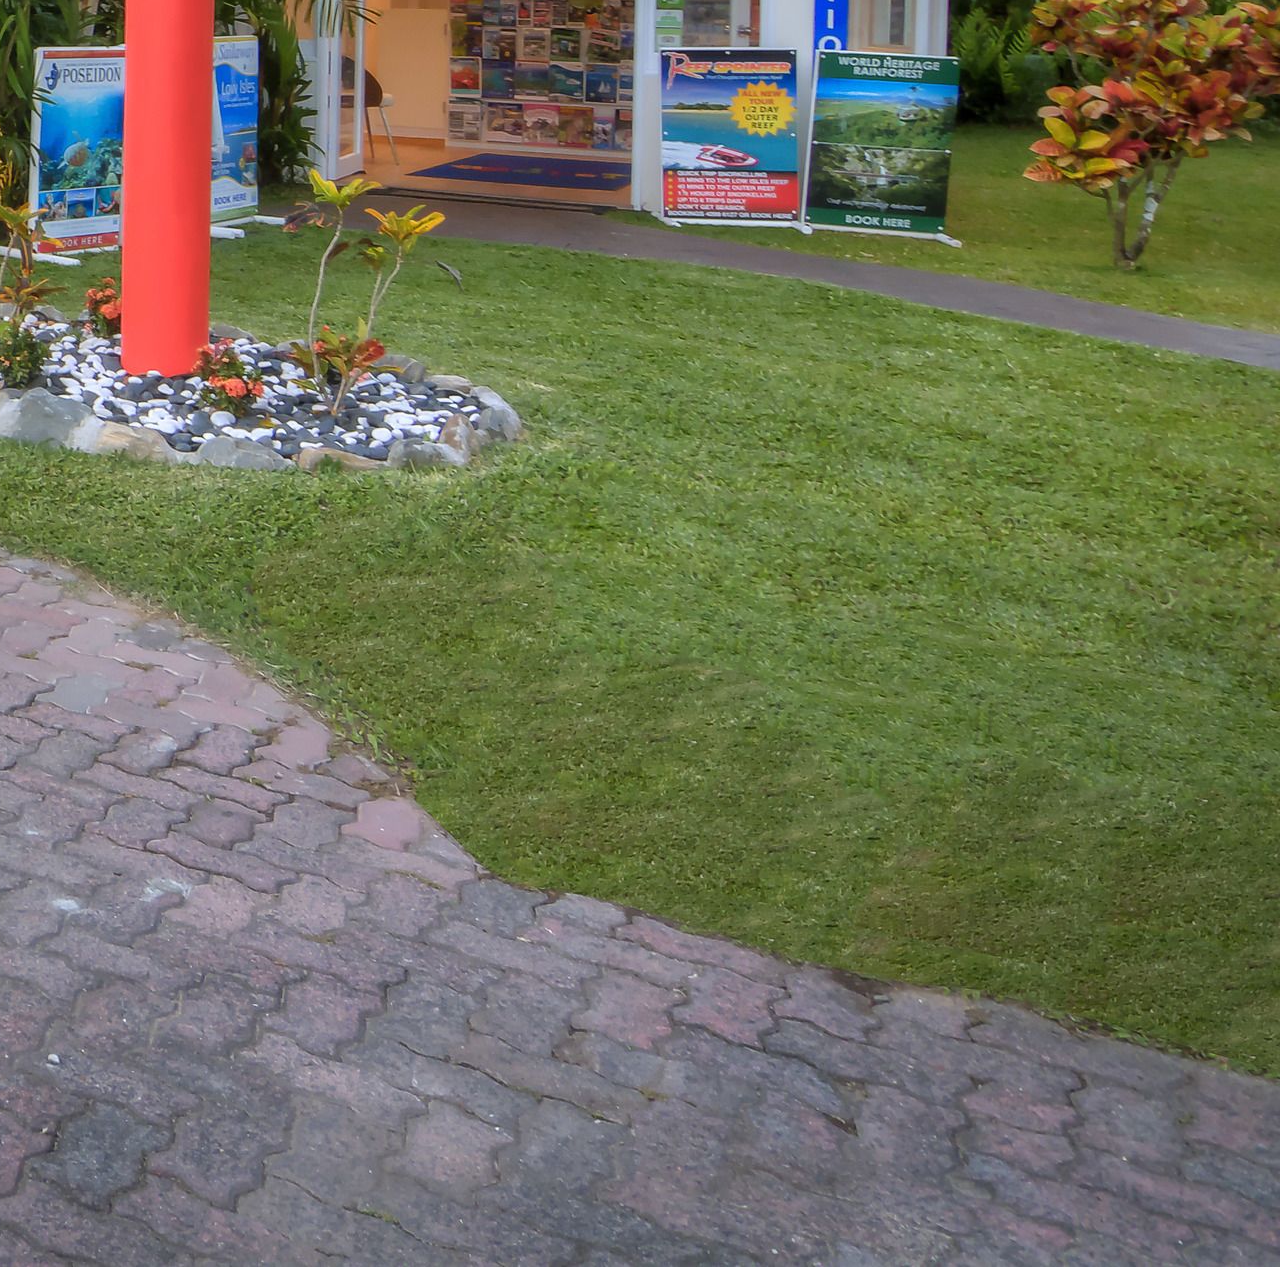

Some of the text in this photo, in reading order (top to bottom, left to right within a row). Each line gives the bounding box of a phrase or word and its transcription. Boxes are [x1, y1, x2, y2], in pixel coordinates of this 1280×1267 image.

[662, 51, 791, 90] REEF SPRINTER
[838, 56, 940, 71] WORLD HERITAGE
[63, 66, 121, 83] POSEIDON
[853, 66, 924, 79] RAINFOREST
[221, 81, 239, 95] Low
[214, 193, 247, 206] BOOK HERE
[845, 214, 911, 228] BOOK HERE
[56, 236, 103, 249] OOK HERE
